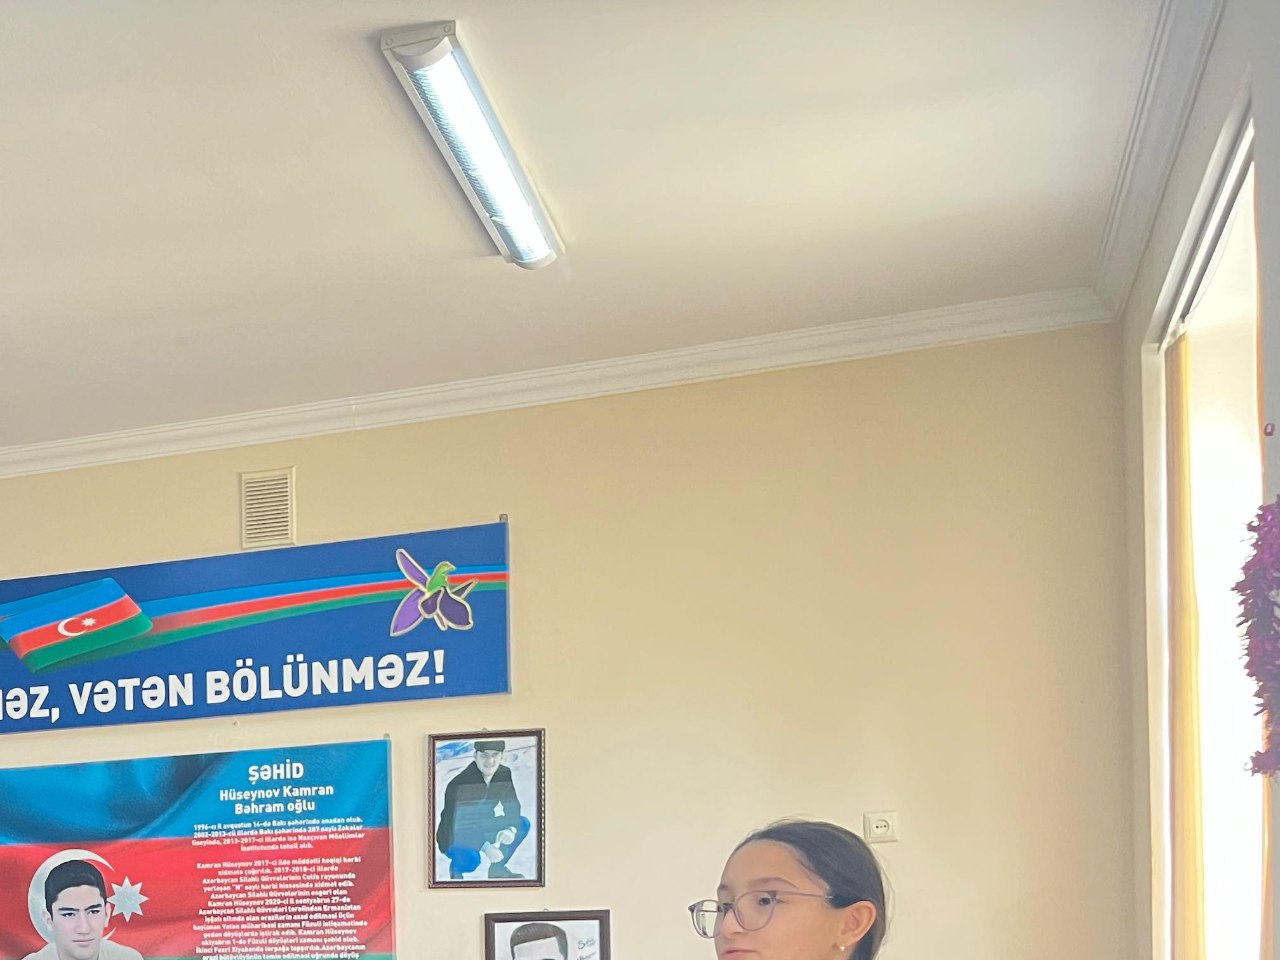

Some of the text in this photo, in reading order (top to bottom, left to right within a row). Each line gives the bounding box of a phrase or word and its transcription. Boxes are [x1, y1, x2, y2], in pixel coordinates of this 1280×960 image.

[69, 672, 193, 715] VƏTƏN
[206, 650, 445, 704] BÖLÜNMƏZ!
[248, 759, 304, 784] ŞƏHİD
[220, 784, 333, 803] Hüseynov Kamran
[235, 800, 315, 814] Bəhram oğlu
